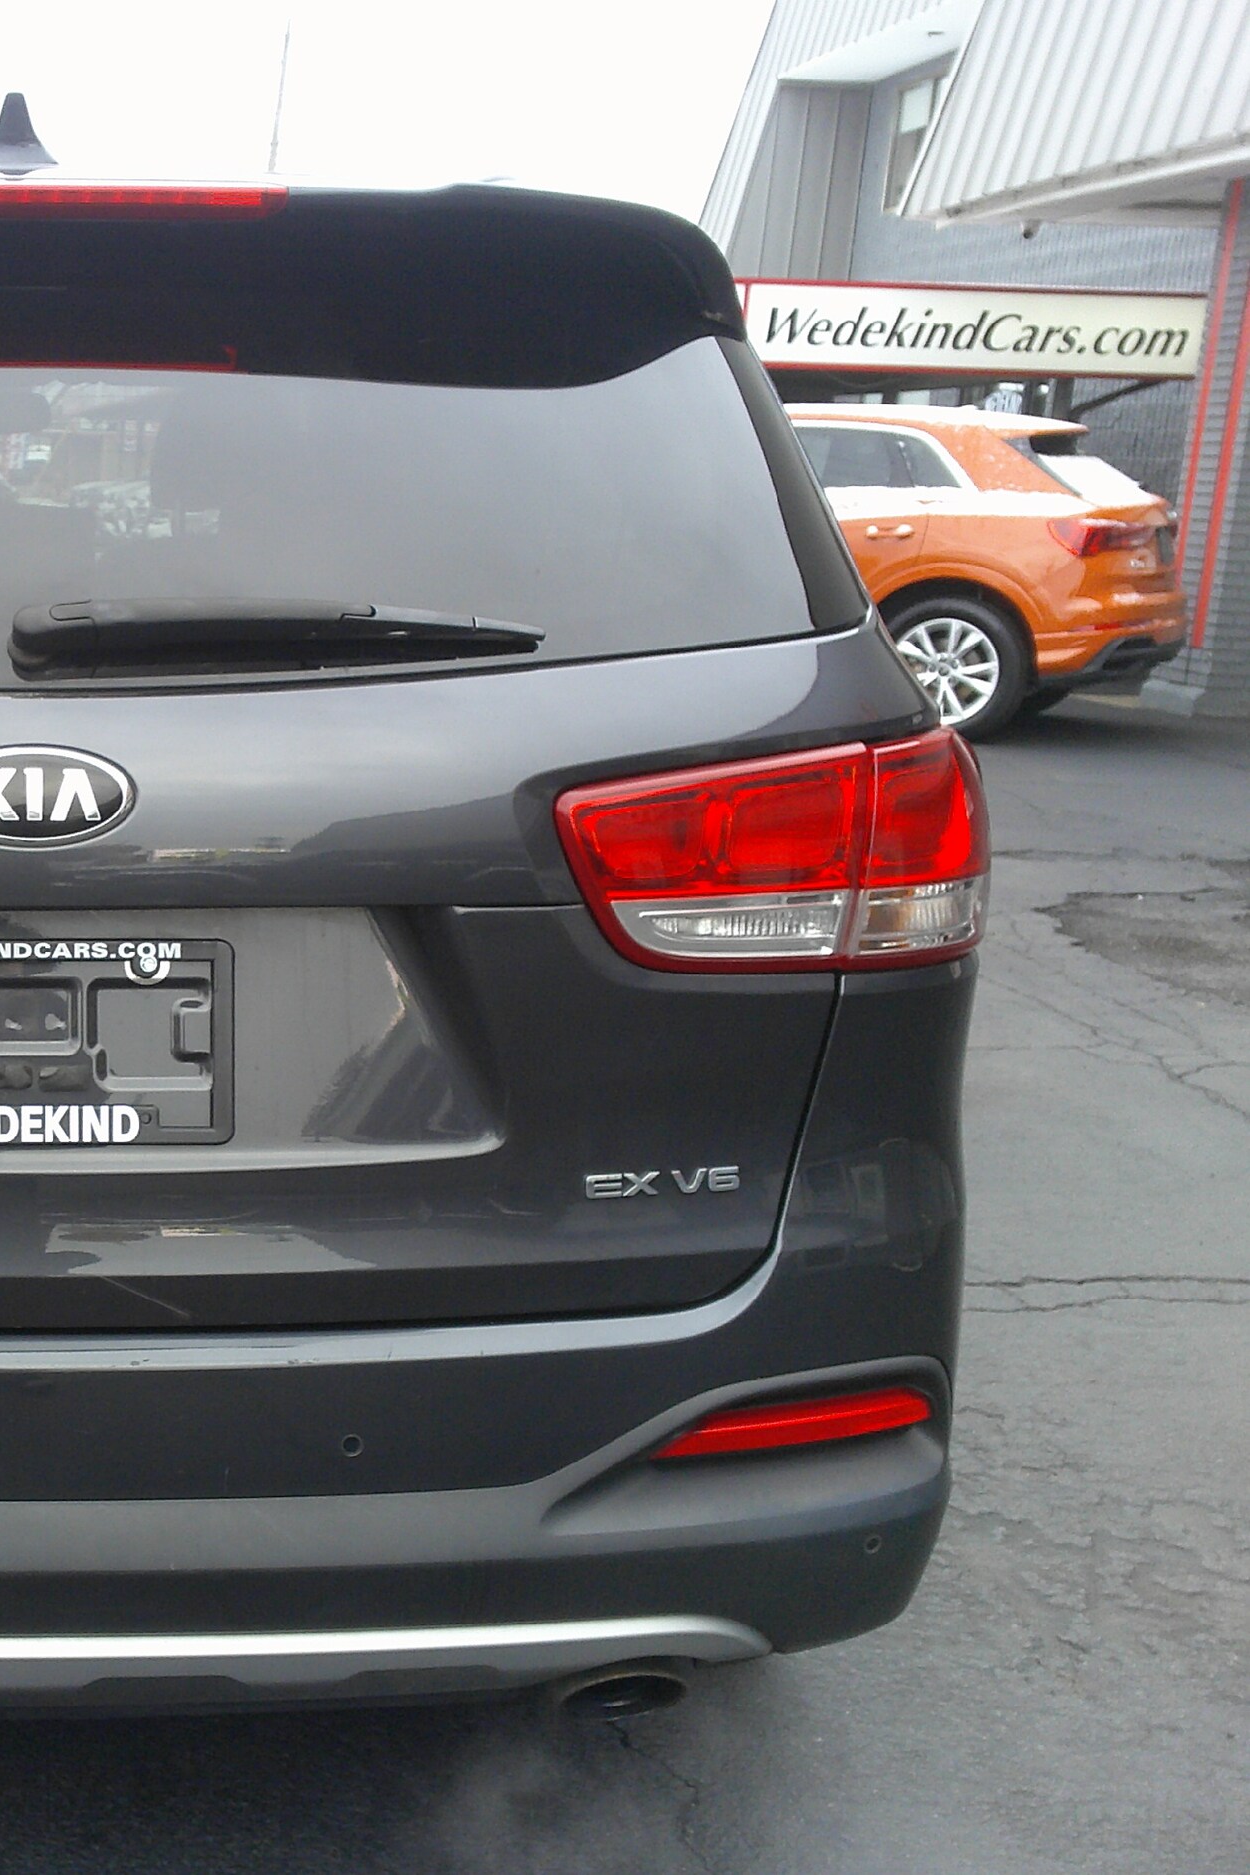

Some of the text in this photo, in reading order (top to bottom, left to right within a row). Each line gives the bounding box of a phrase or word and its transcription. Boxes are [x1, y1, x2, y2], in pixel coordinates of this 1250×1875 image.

[765, 306, 1191, 358] WedekindCars.com
[586, 1165, 740, 1199] EX V6
